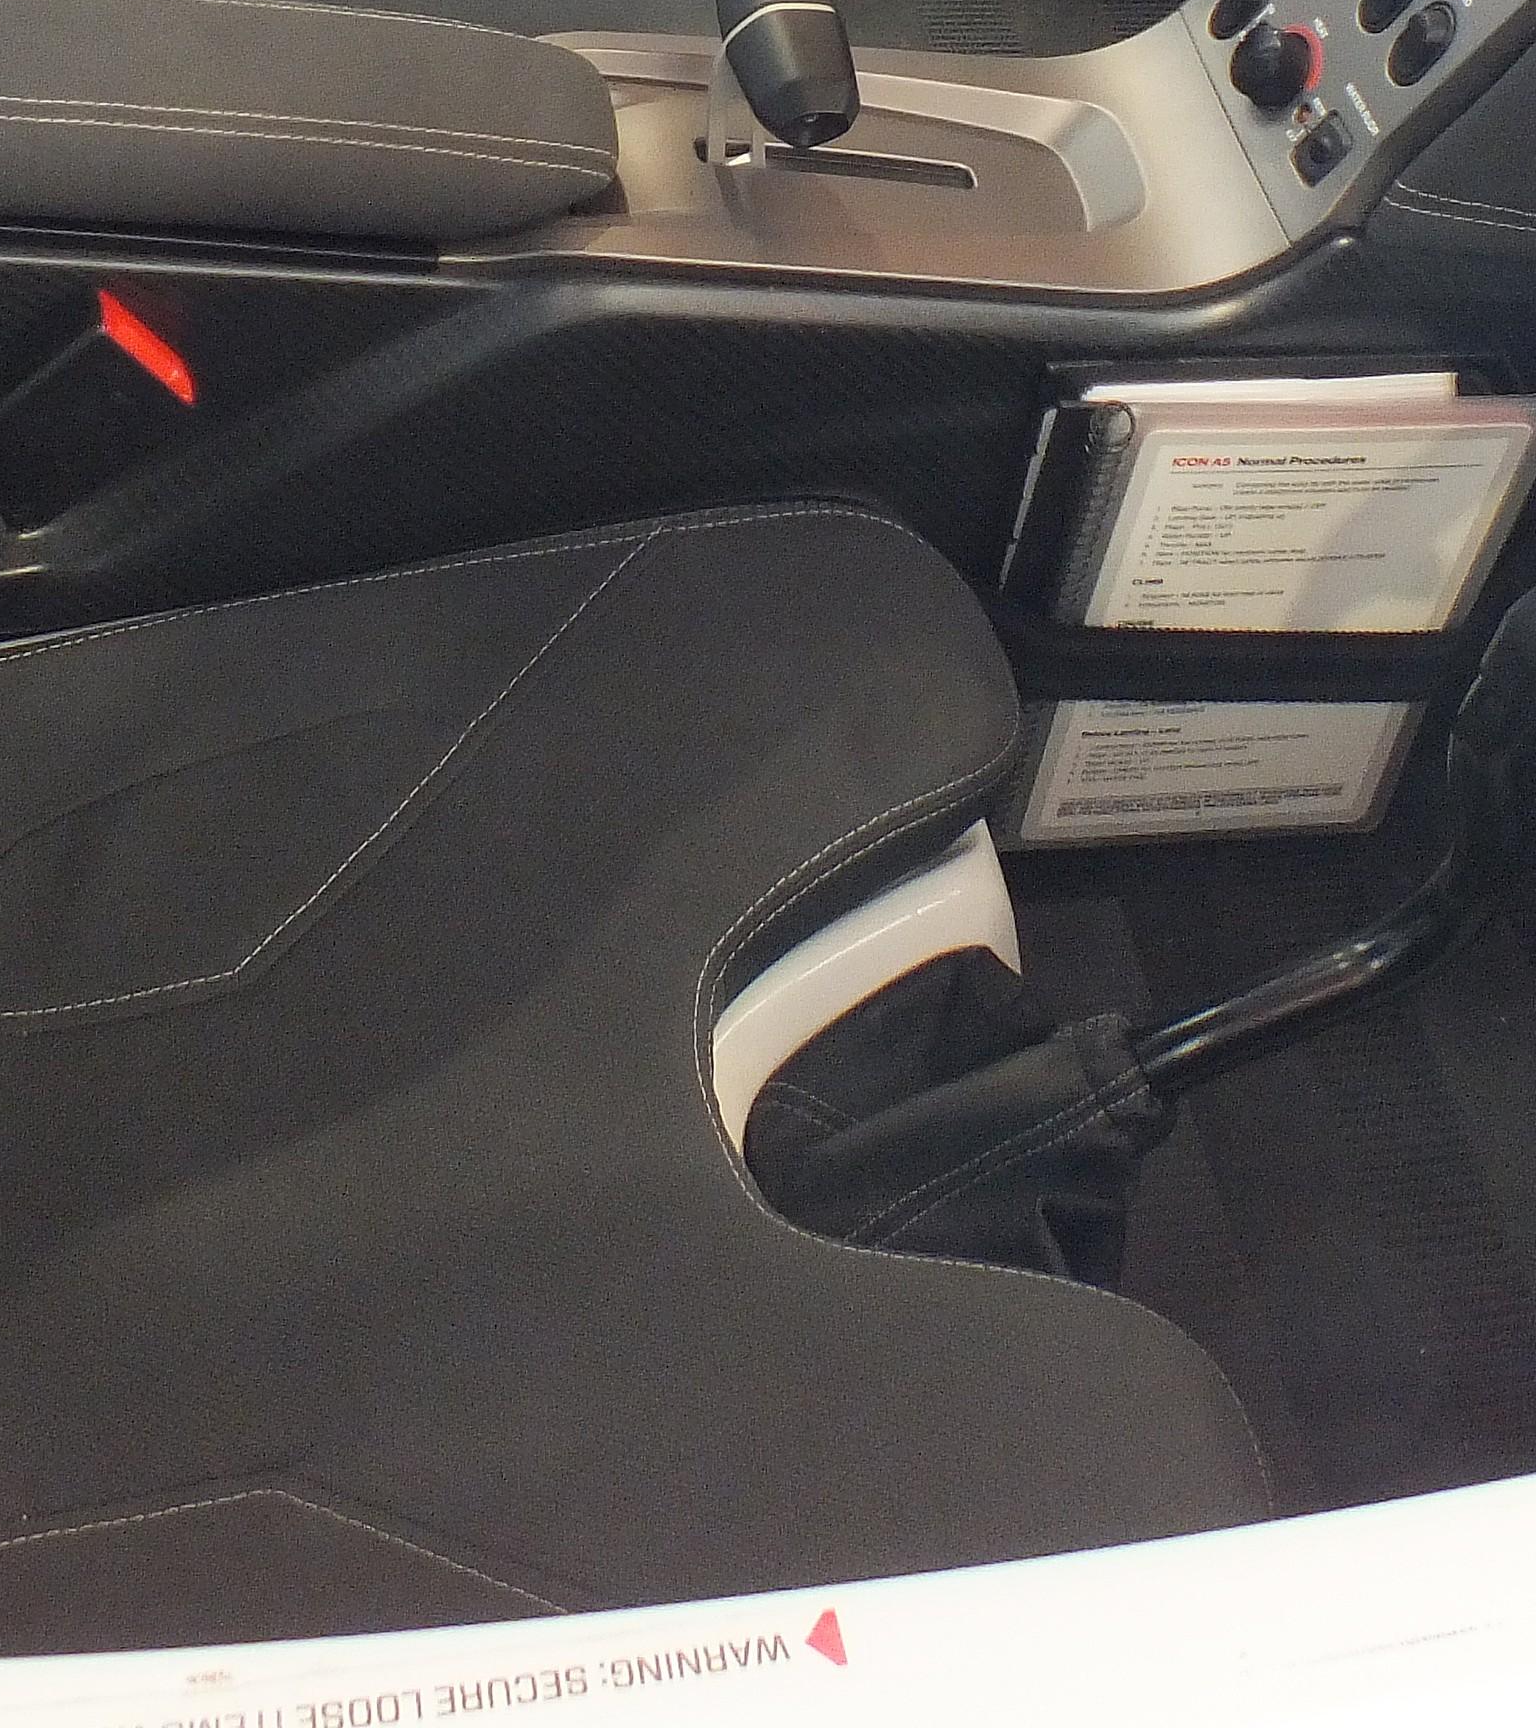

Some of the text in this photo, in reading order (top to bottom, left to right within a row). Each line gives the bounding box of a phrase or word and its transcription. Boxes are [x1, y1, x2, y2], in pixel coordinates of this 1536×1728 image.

[1172, 455, 1367, 467] ICON A5 Normal Procedures
[599, 1633, 791, 1689] WARNING:
[296, 1688, 423, 1728] LOOSE
[434, 1666, 588, 1718] SECURE
